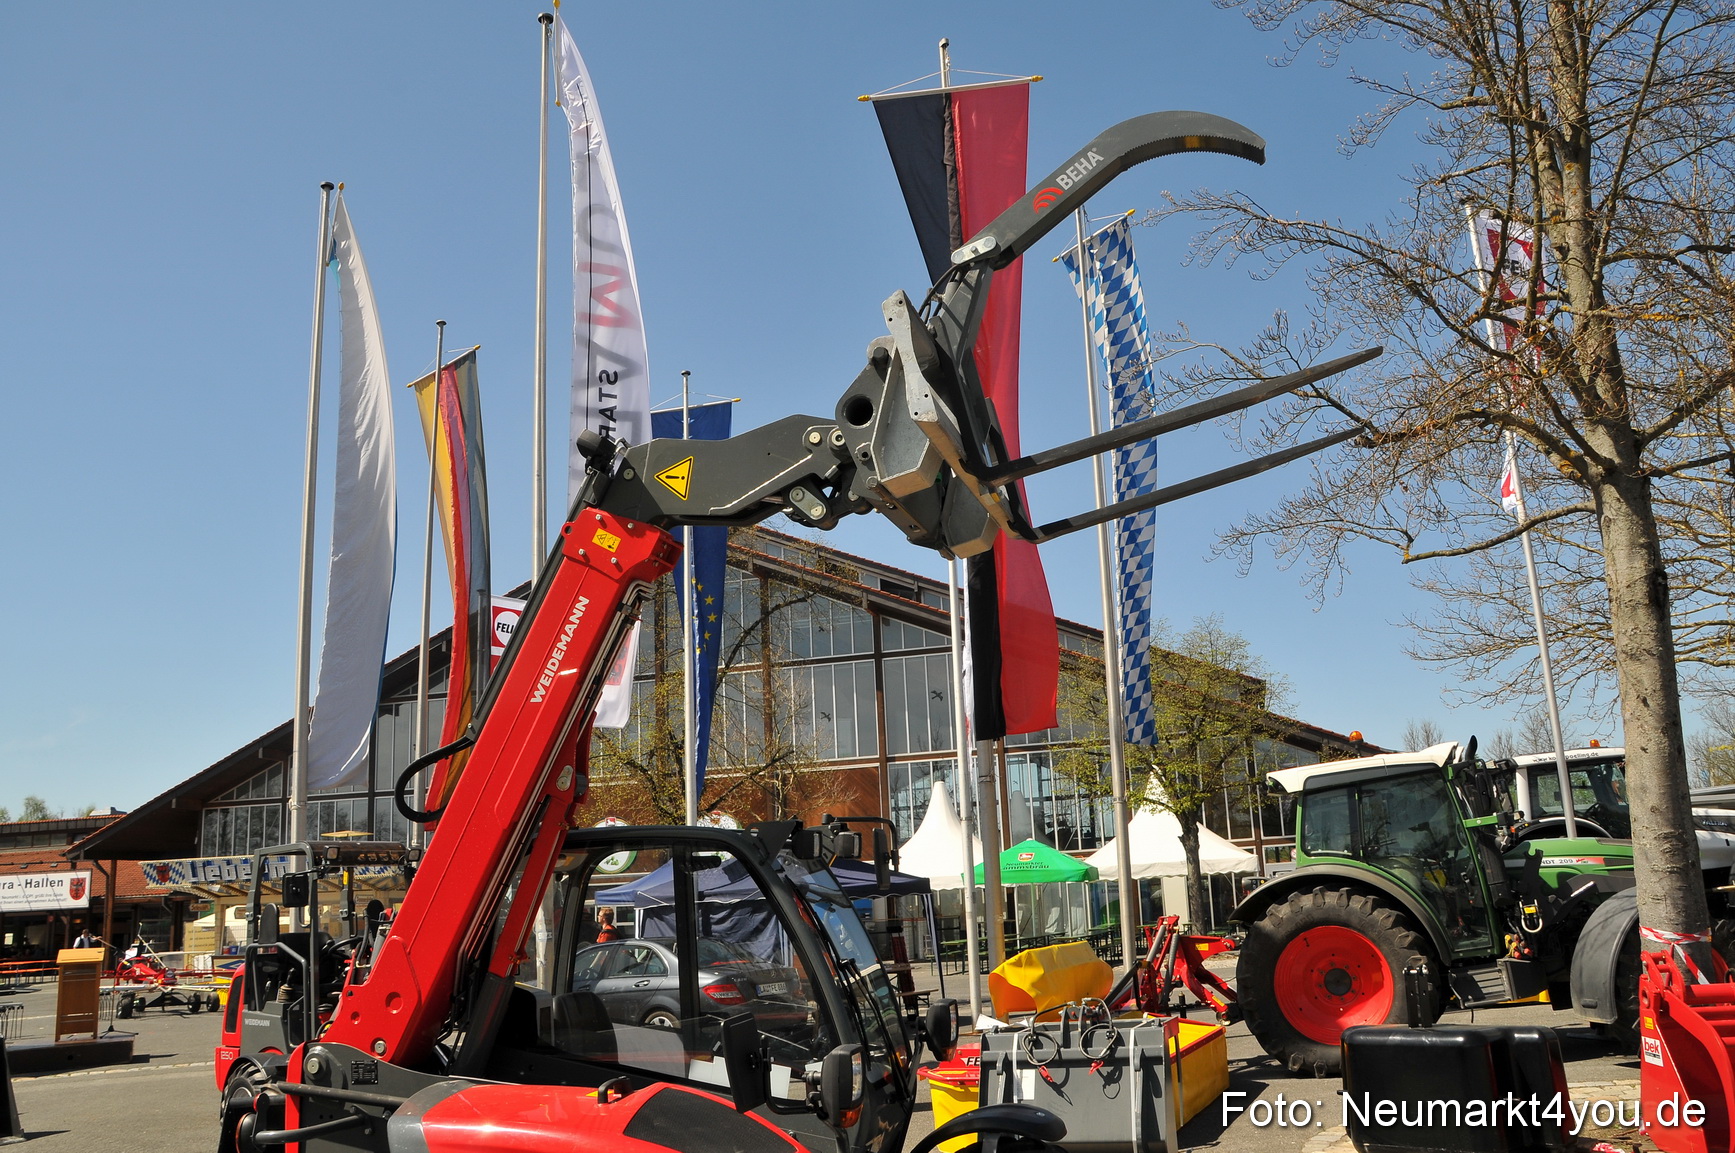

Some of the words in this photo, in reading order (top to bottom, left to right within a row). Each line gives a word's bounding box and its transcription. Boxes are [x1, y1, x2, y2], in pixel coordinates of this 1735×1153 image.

[1055, 150, 1104, 191] BEHA
[529, 595, 590, 703] WEIDEMANN
[24, 878, 64, 889] Hallen
[244, 1018, 271, 1027] WEIDEMANN
[1643, 1037, 1660, 1054] bek
[966, 1056, 981, 1067] FE
